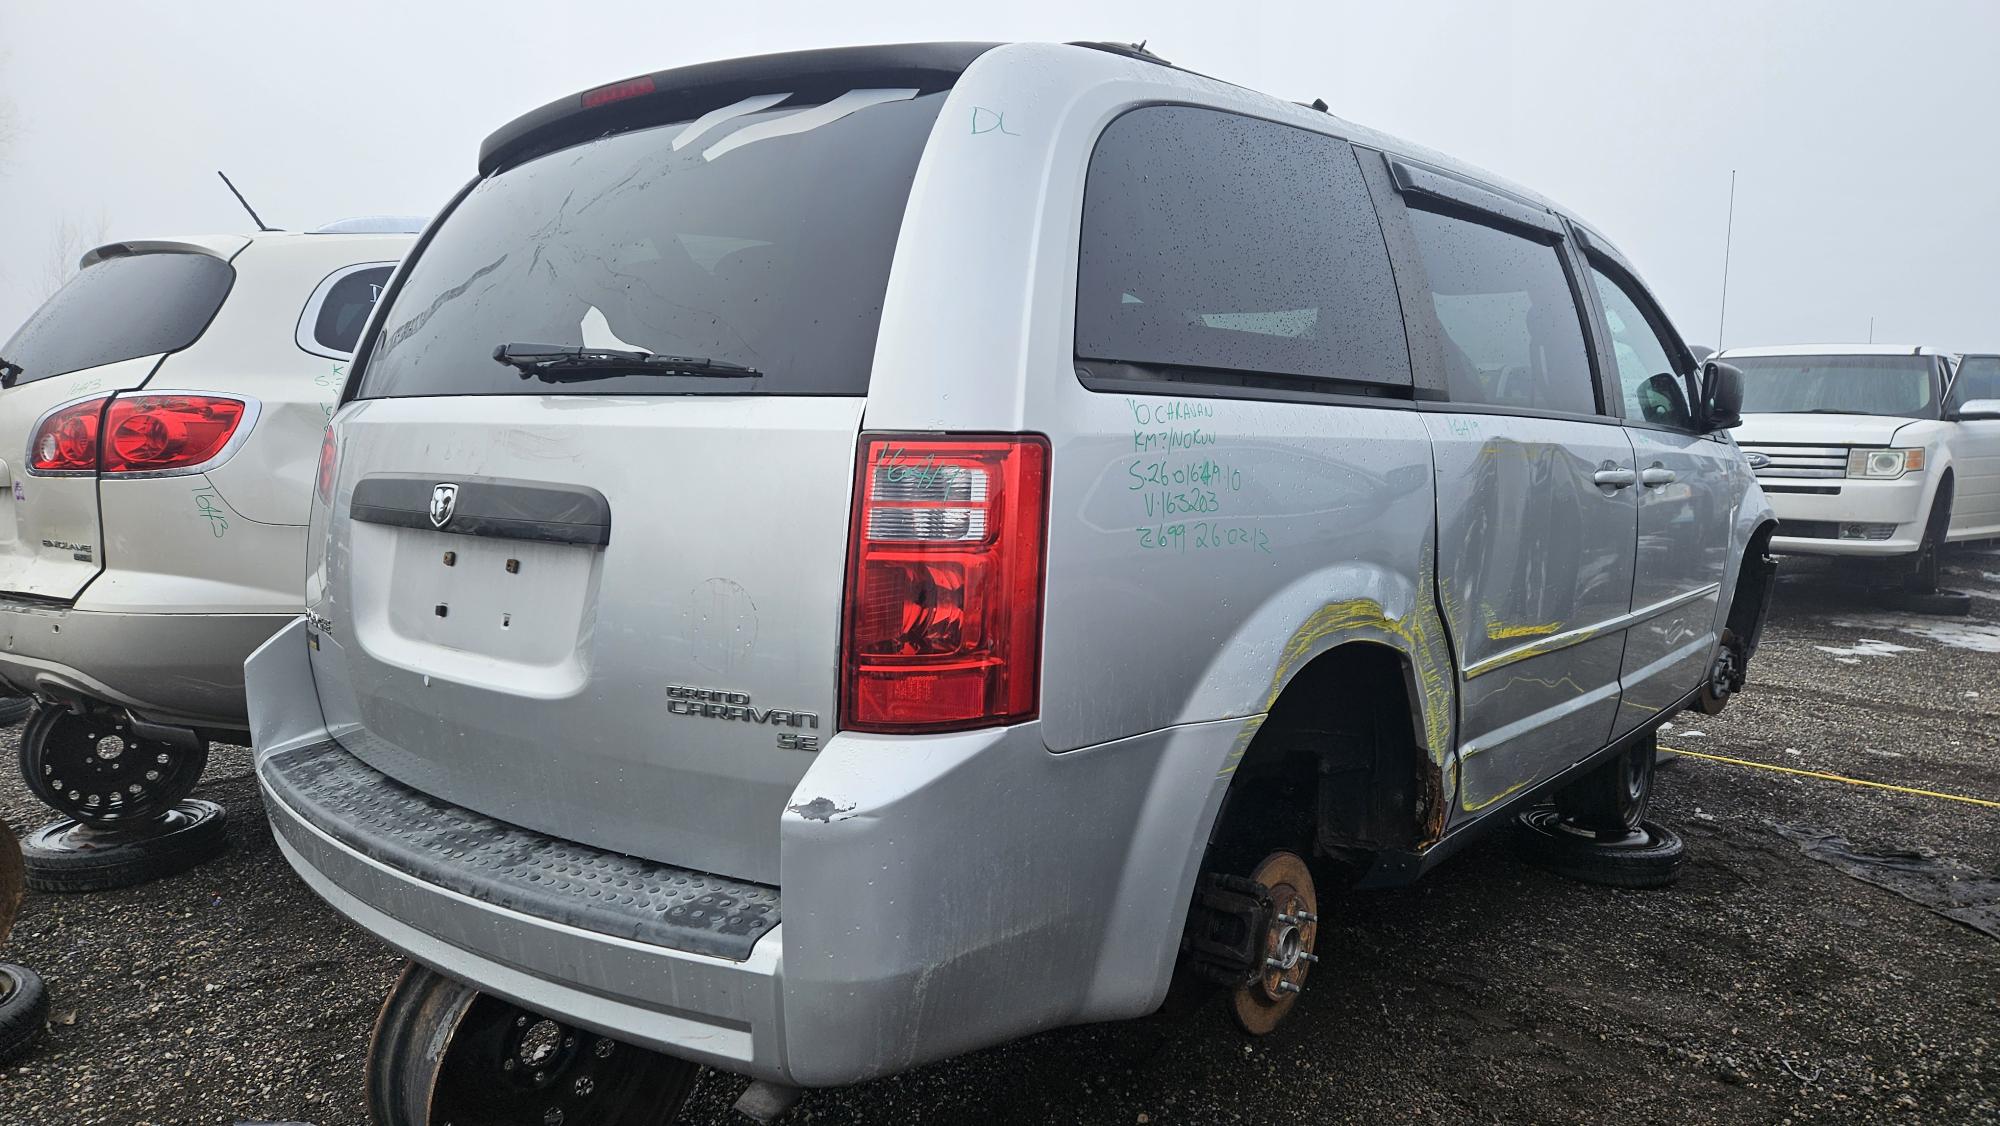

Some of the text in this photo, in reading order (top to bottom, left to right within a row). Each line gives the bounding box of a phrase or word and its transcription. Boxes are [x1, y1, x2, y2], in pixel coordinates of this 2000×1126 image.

[1154, 400, 1214, 424] CARAVAN
[666, 685, 750, 705] GRAND
[667, 699, 818, 729] CARAVAN
[776, 732, 818, 752] SE
